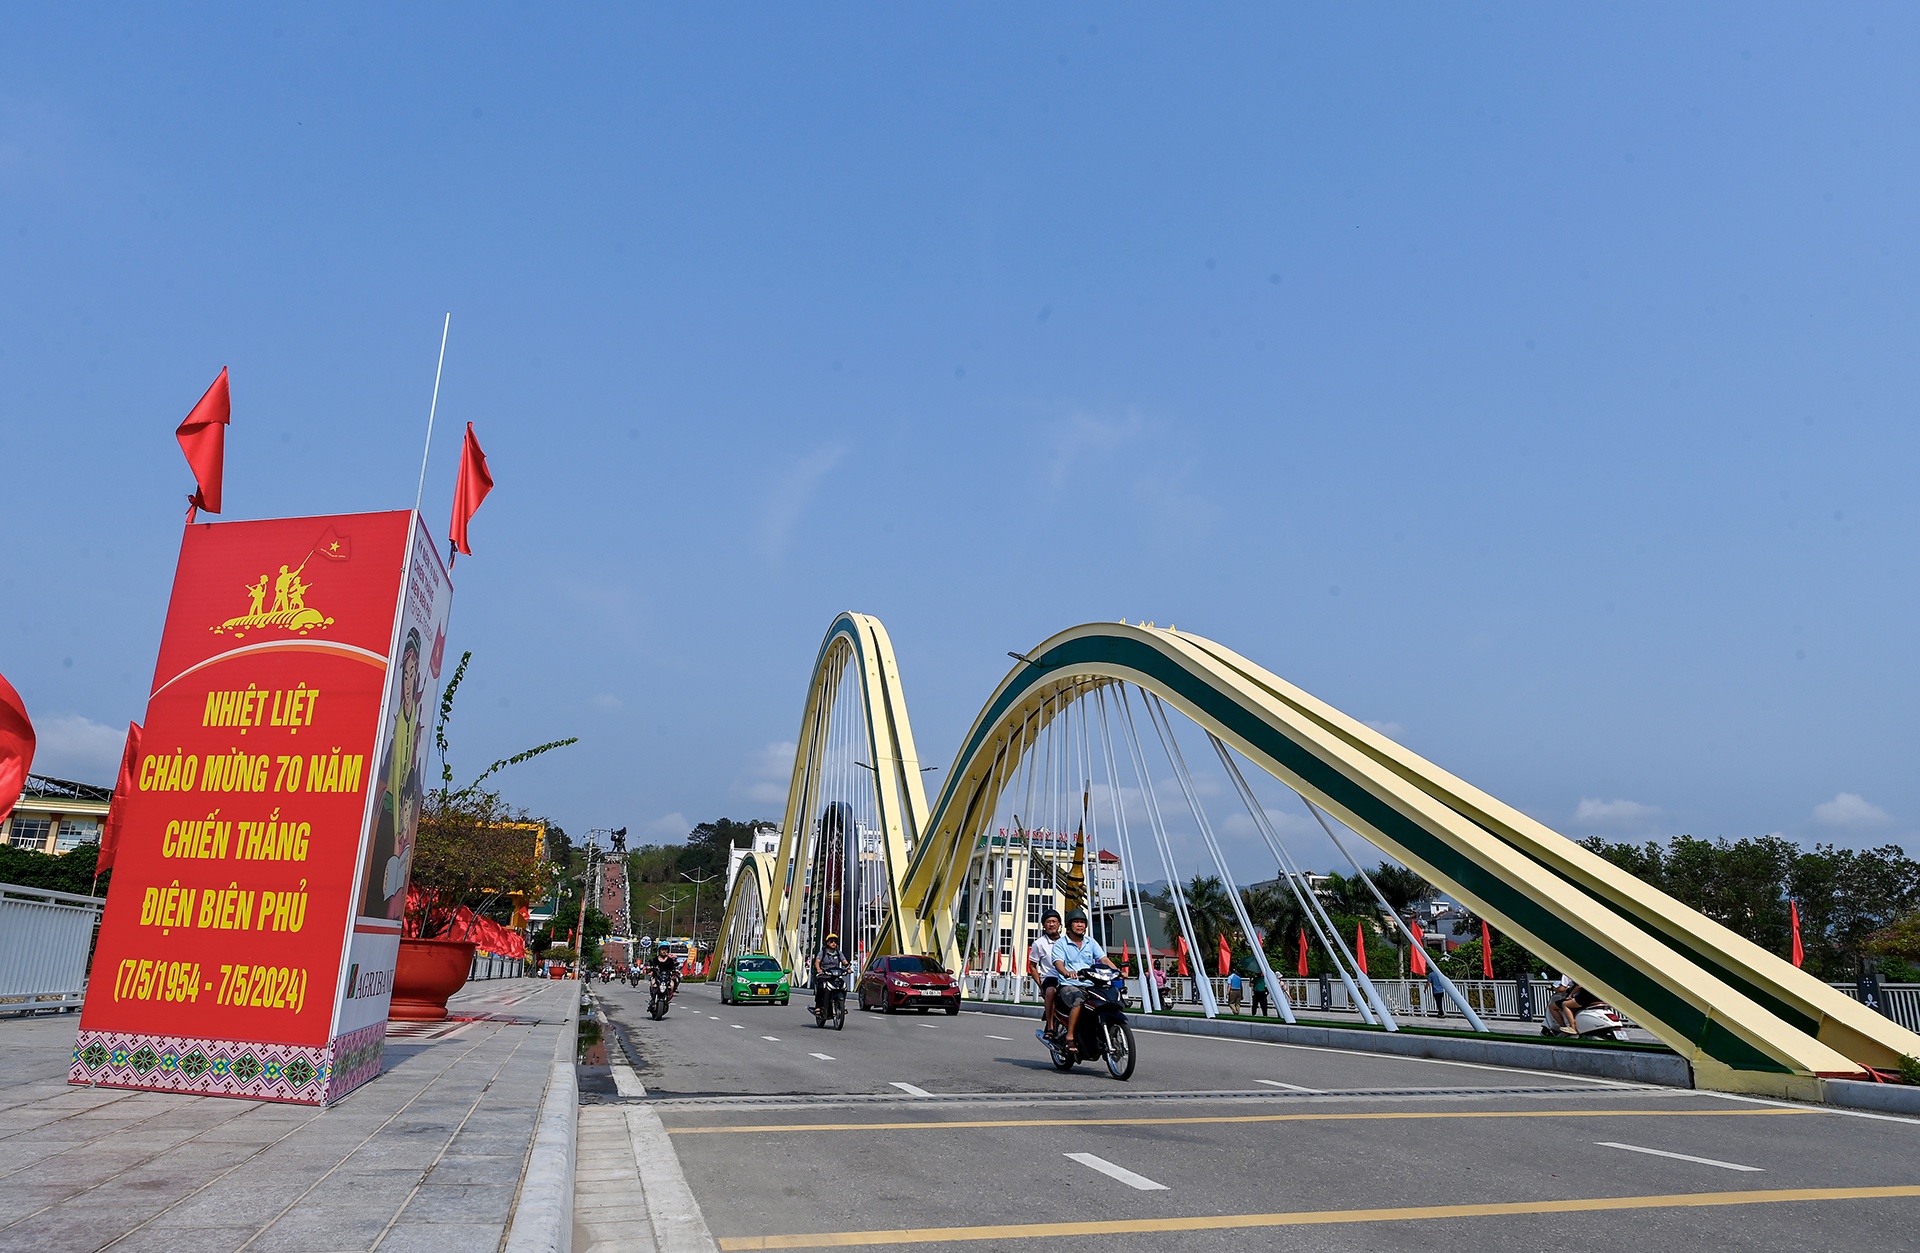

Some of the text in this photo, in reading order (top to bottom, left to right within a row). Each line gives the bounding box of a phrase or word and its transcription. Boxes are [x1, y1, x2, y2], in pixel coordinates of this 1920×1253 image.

[203, 681, 320, 736] NHIỆT LIỆT
[138, 745, 364, 794] CHÀO MỪNG 70 NĂM
[162, 805, 311, 862] CHIẾN THẮNG
[139, 878, 308, 936] ĐIỆN BIÊN PHỦ
[113, 958, 200, 1004] (7/5/1954
[216, 962, 307, 1013] 7/5/2024)
